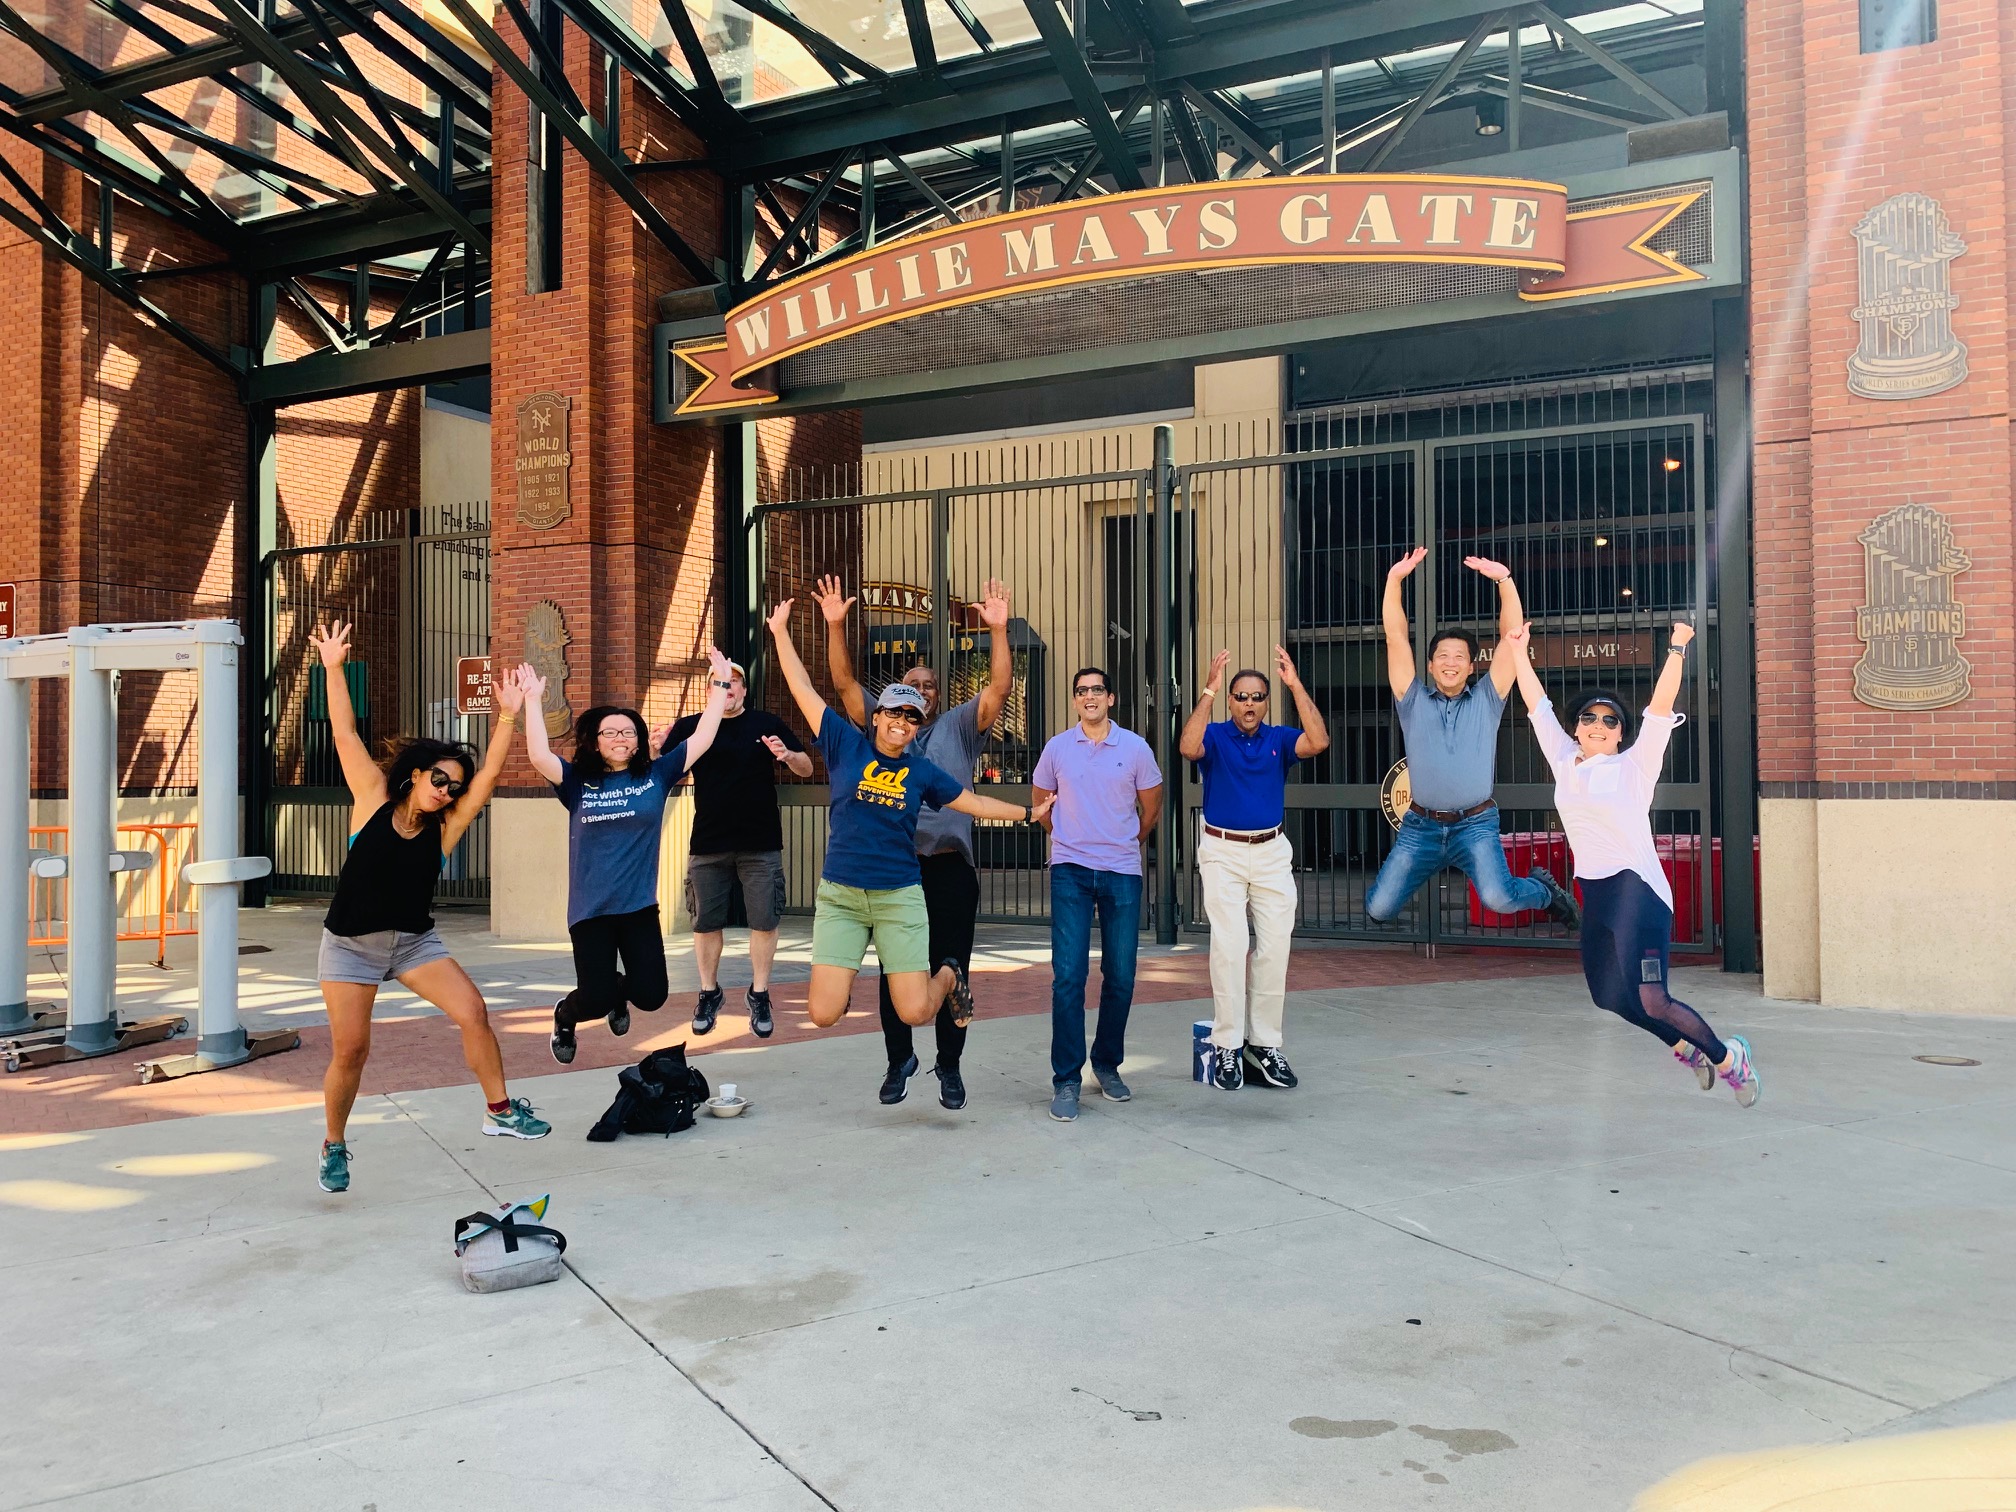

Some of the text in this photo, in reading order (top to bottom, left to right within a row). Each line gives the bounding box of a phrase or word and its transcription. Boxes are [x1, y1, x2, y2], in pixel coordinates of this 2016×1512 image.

[734, 193, 1539, 357] WILLIE MAYS GATE
[1853, 297, 1958, 319] CHAMPIONS
[1863, 291, 1946, 308] WORLD SERIES
[1856, 373, 1884, 388] ORLD
[1911, 363, 1959, 388] CHAMPIO
[524, 437, 559, 454] WORLD
[515, 453, 569, 471] CHAMPIONS
[523, 473, 560, 485] 1905 1921
[524, 486, 561, 499] 1922 1933
[534, 502, 550, 512] 1954
[442, 511, 462, 528] The
[532, 517, 554, 526] GIANTS
[462, 568, 482, 581] and
[862, 588, 933, 613] MAYS
[1862, 604, 1907, 615] WORLD
[1861, 610, 1961, 638] CHAMPIONS
[874, 640, 918, 655] HEY
[1574, 643, 1620, 659] RAMP
[1861, 680, 1962, 699] ORLD SERIES CHAMPIO
[467, 697, 491, 706] GAME
[860, 760, 910, 793] Cal
[600, 788, 623, 800] With
[624, 779, 655, 796] Digital
[857, 784, 905, 800] ADVENTURES
[582, 798, 628, 809] Certainty
[1383, 793, 1393, 813] SAN
